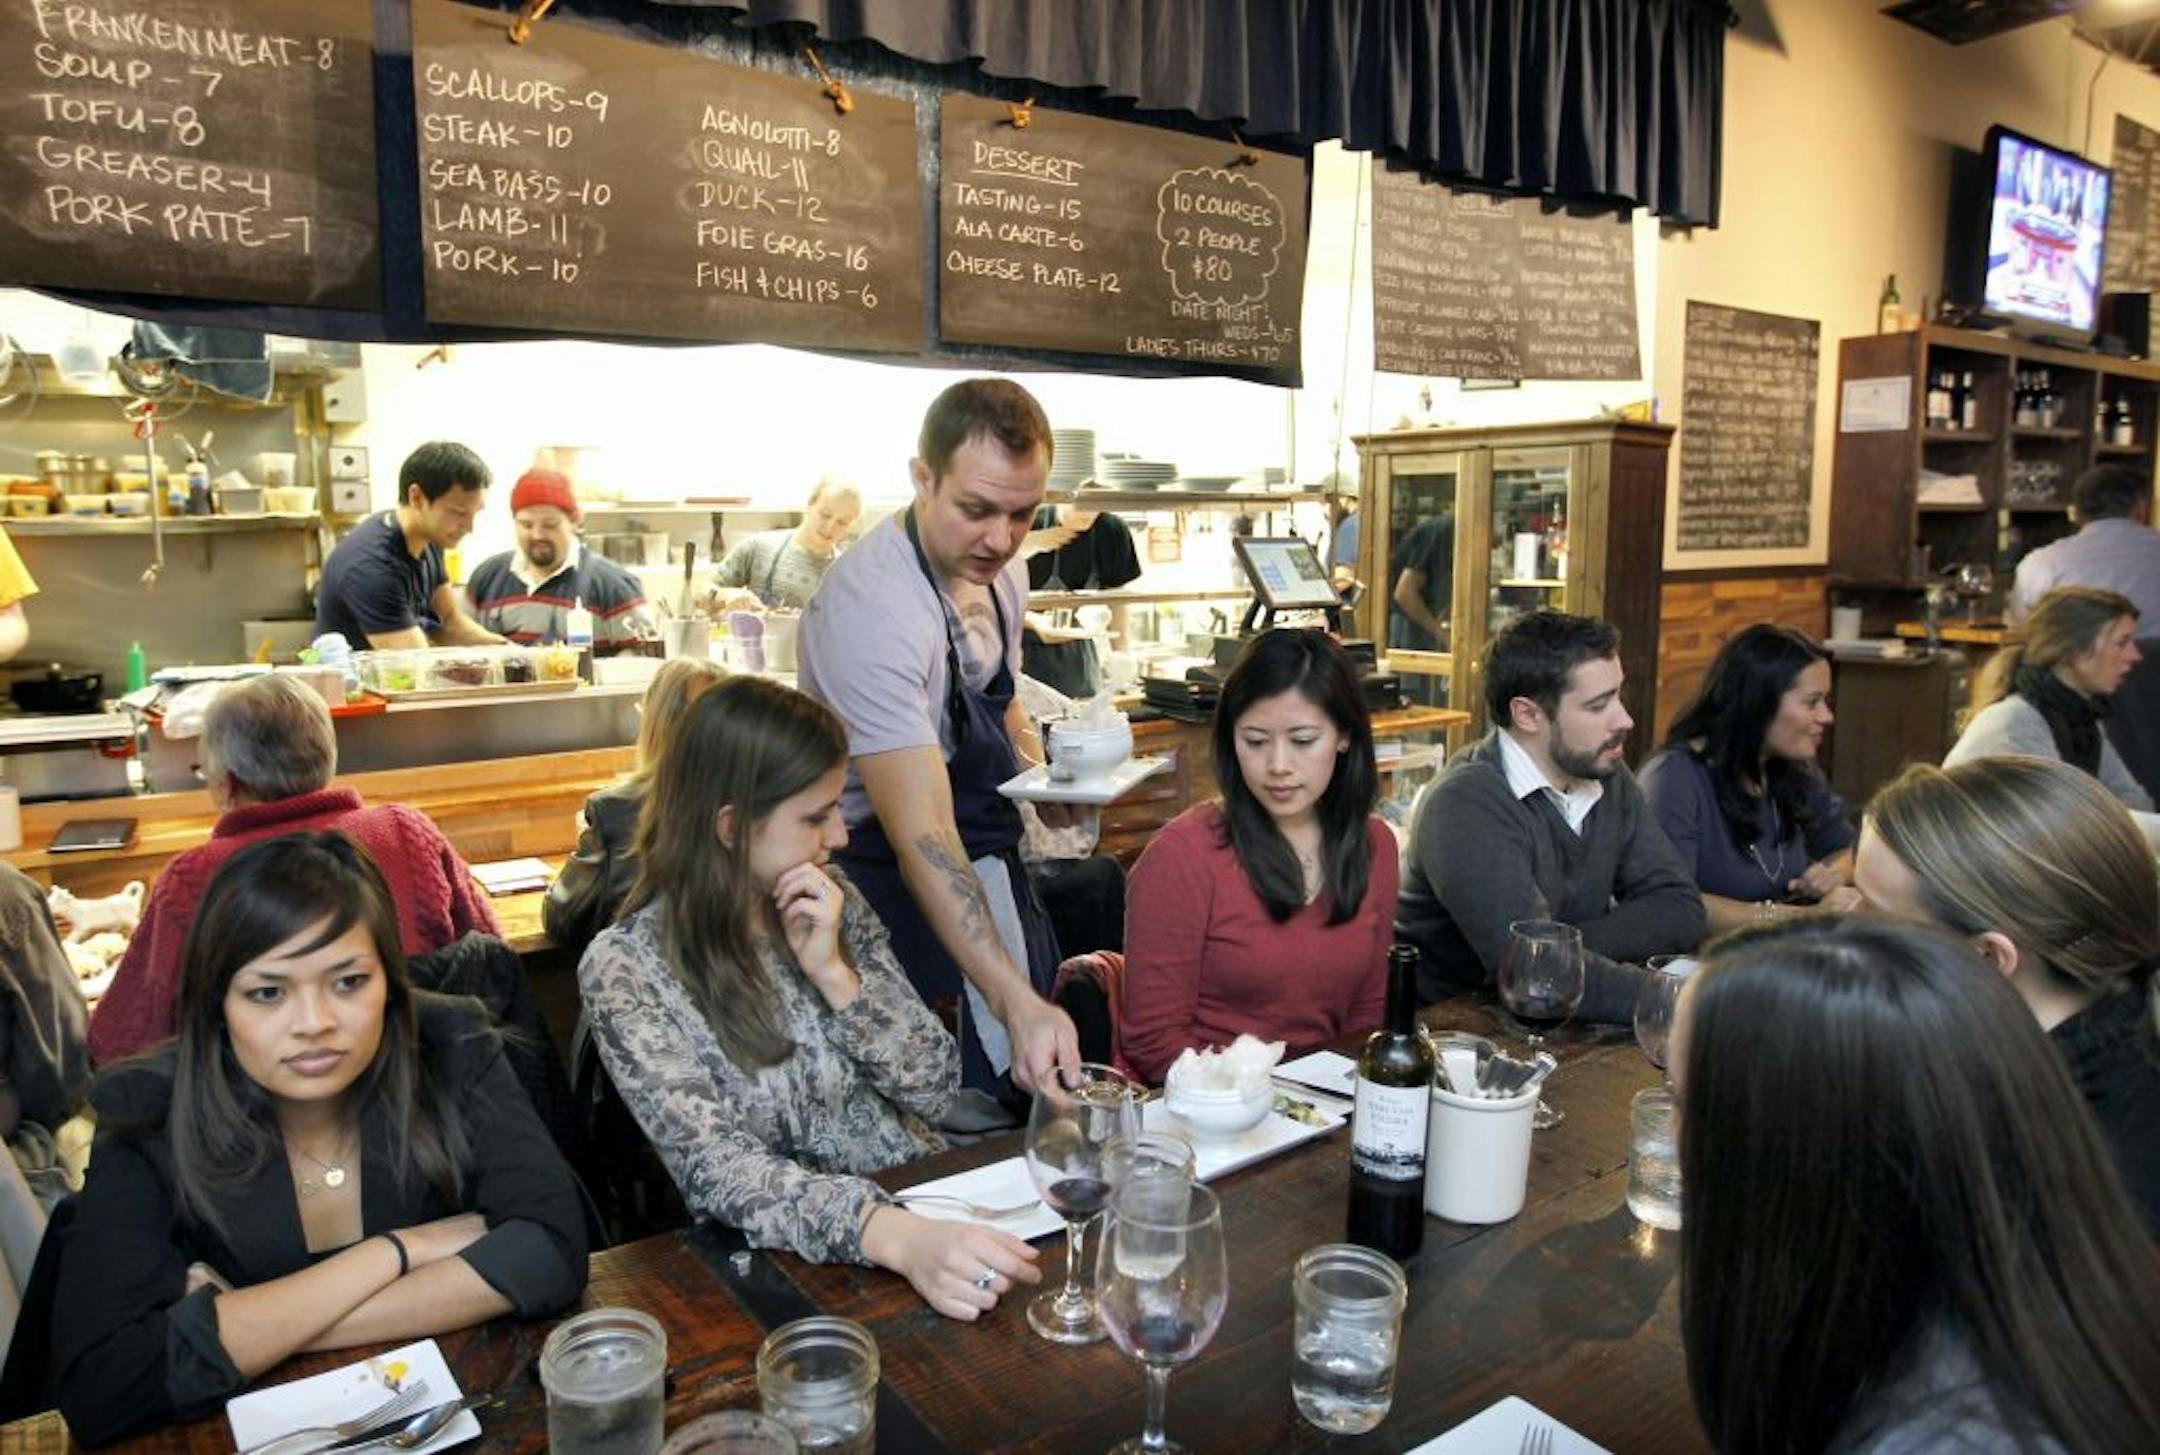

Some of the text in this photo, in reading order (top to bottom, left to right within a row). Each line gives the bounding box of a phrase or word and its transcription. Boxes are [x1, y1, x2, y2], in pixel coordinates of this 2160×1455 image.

[429, 159, 486, 192] SEA
[974, 140, 1085, 182] DESSERT
[45, 185, 153, 235] PORK
[1173, 188, 1273, 227] 10 COURSES
[697, 220, 755, 250] FOIE
[1175, 227, 1261, 256] 2 PEOPLE
[696, 262, 748, 294] FISH
[946, 250, 1024, 281] CHEESE
[1171, 301, 1208, 321] DATE
